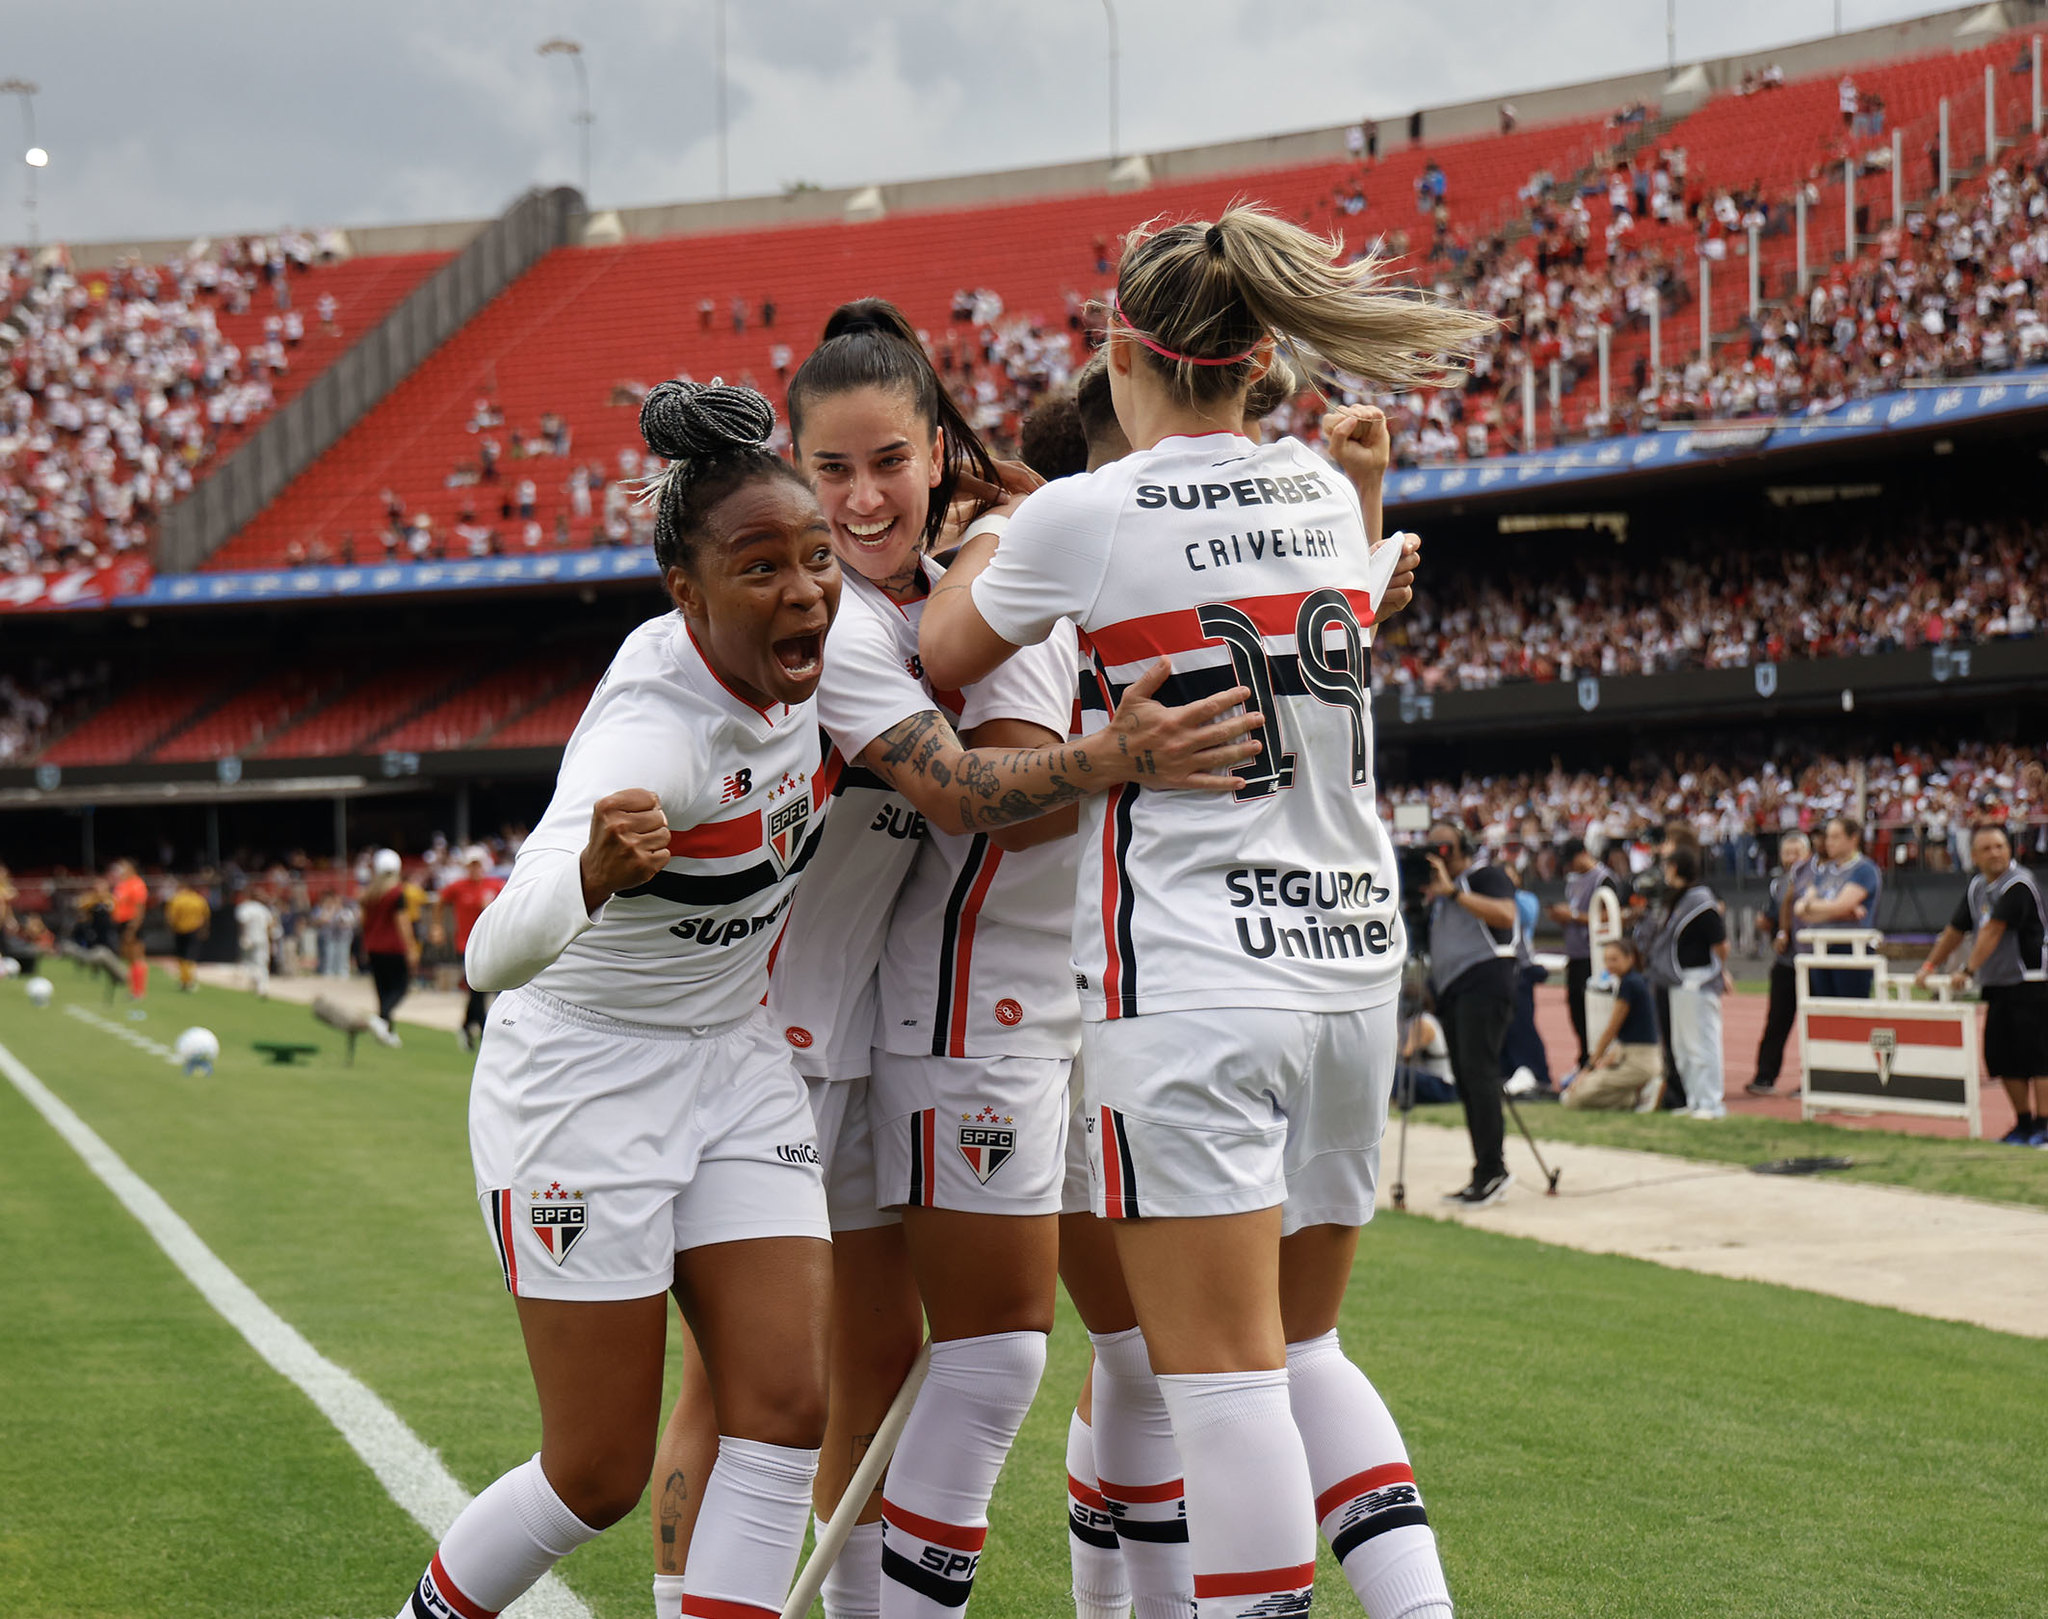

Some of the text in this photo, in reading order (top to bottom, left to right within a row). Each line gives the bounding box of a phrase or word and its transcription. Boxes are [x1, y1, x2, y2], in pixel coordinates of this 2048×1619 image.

[1136, 471, 1333, 510] SUPERBET
[1185, 528, 1339, 571] CRIVELARI
[1195, 586, 1368, 804] 19
[772, 800, 808, 833] SPFC
[963, 1131, 1011, 1146] SPFC
[533, 1209, 583, 1222] SPFC
[422, 1574, 463, 1619] SP
